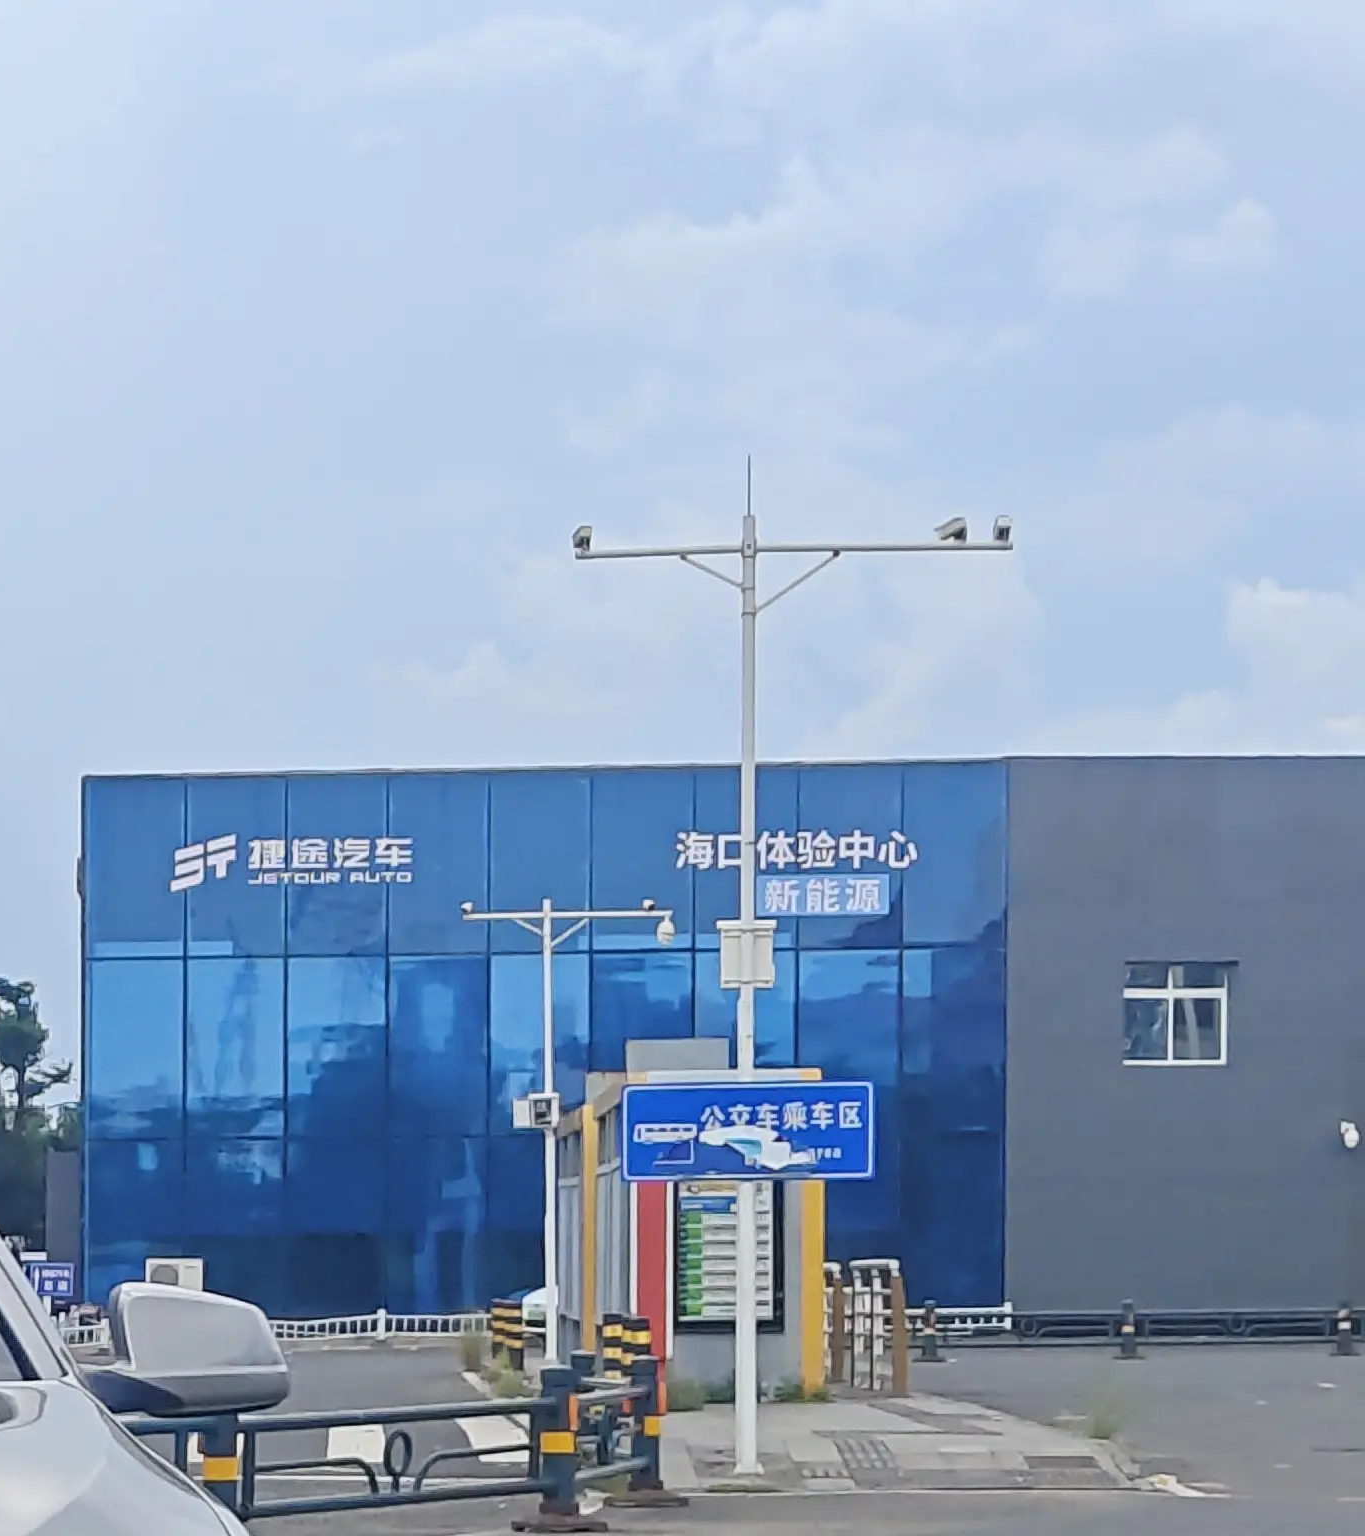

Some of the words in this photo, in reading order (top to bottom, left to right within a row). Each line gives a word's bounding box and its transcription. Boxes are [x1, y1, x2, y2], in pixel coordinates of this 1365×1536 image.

[247, 837, 413, 869] 捷途汽车
[675, 829, 918, 870] 海口体验中心
[247, 871, 341, 884] JETOUR
[349, 871, 413, 884] AUTO
[764, 877, 881, 913] 新能源
